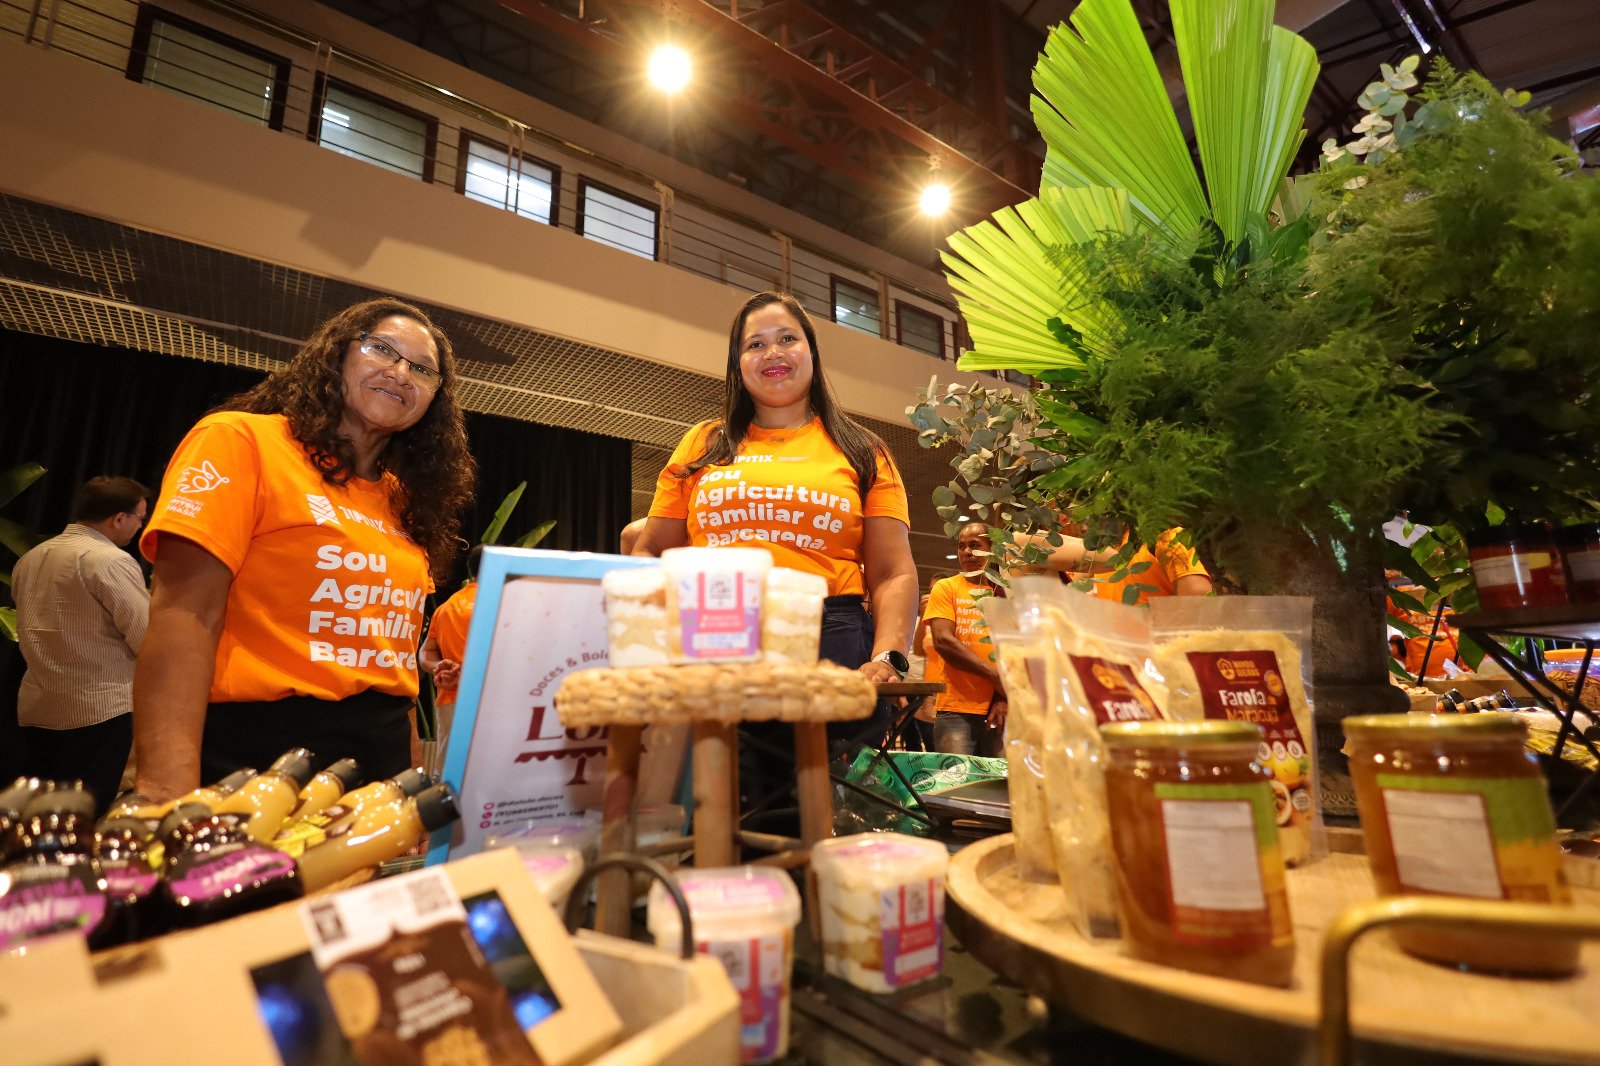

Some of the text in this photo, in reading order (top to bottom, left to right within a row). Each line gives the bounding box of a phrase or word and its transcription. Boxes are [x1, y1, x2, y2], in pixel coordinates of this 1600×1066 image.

[694, 480, 851, 514] Agricultura
[696, 502, 843, 534] Familiar de
[315, 544, 387, 573] Sou
[529, 666, 564, 697] Doces
